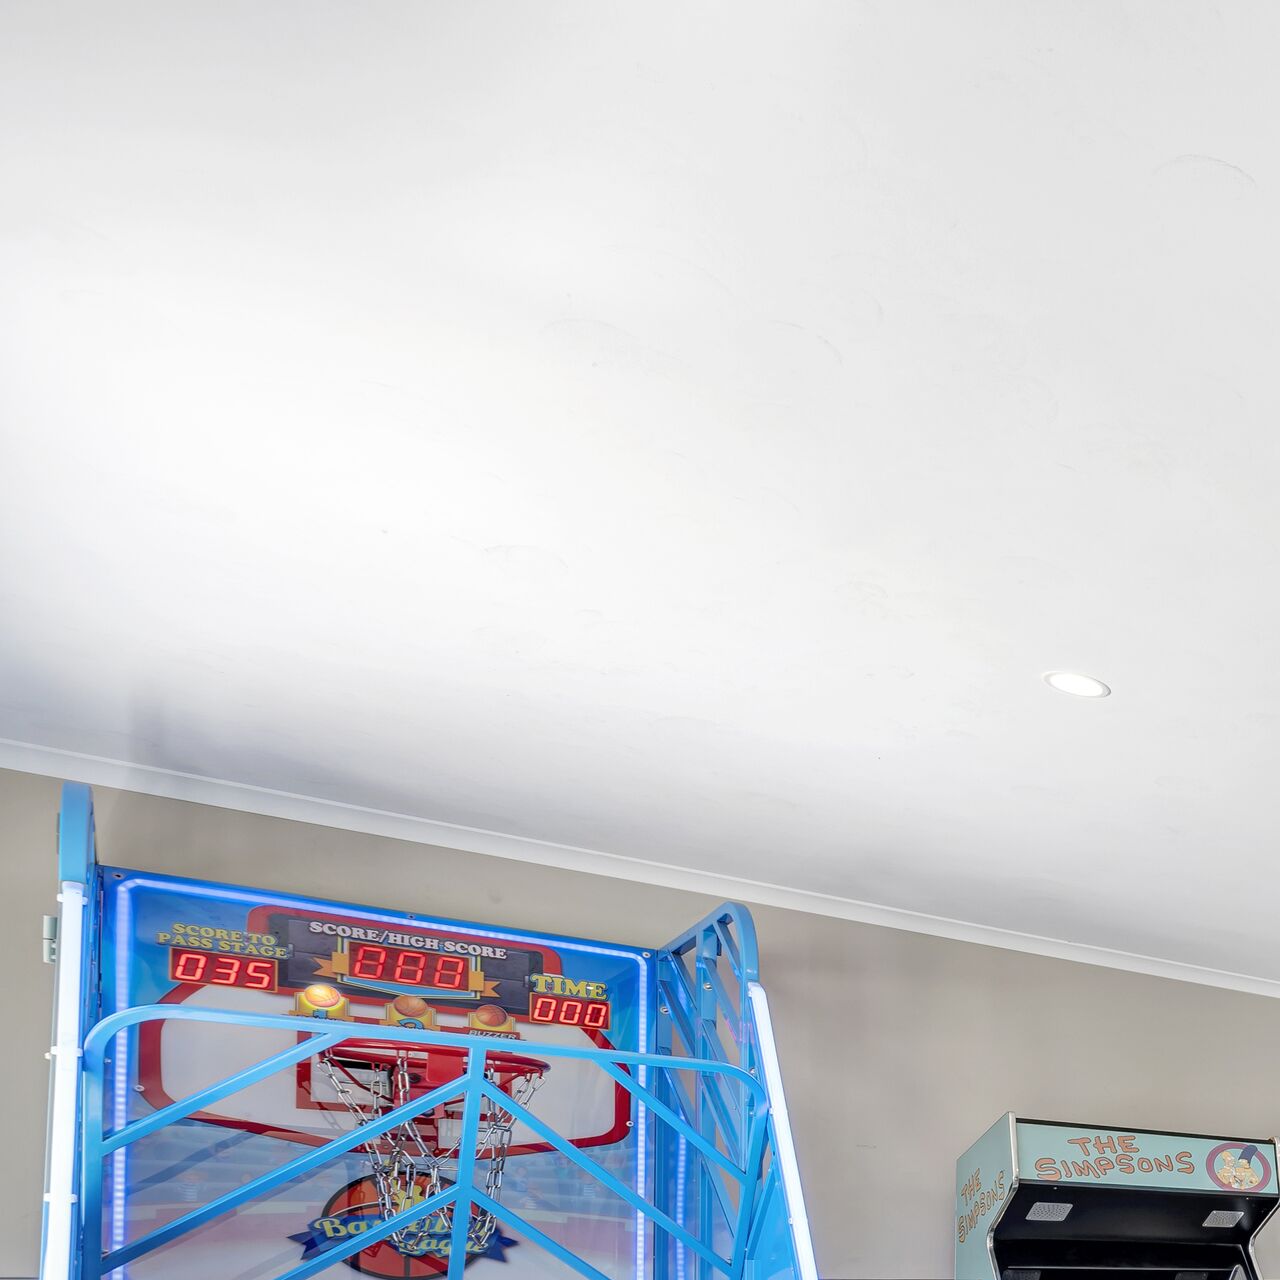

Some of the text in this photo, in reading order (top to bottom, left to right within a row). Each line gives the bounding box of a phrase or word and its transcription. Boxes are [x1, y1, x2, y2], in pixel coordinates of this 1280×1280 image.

[156, 932, 288, 959] PASS STAGE
[172, 923, 277, 946] SCORE TO
[309, 921, 507, 960] SCORE/HIGH SCORE
[175, 953, 273, 989] 035
[530, 973, 609, 1000] TIME
[533, 998, 607, 1027] 000
[1067, 1135, 1140, 1156] THE
[1035, 1151, 1195, 1181] SIMPSONS
[961, 1168, 982, 1207] THE
[958, 1170, 1005, 1243] SIMPSONS
